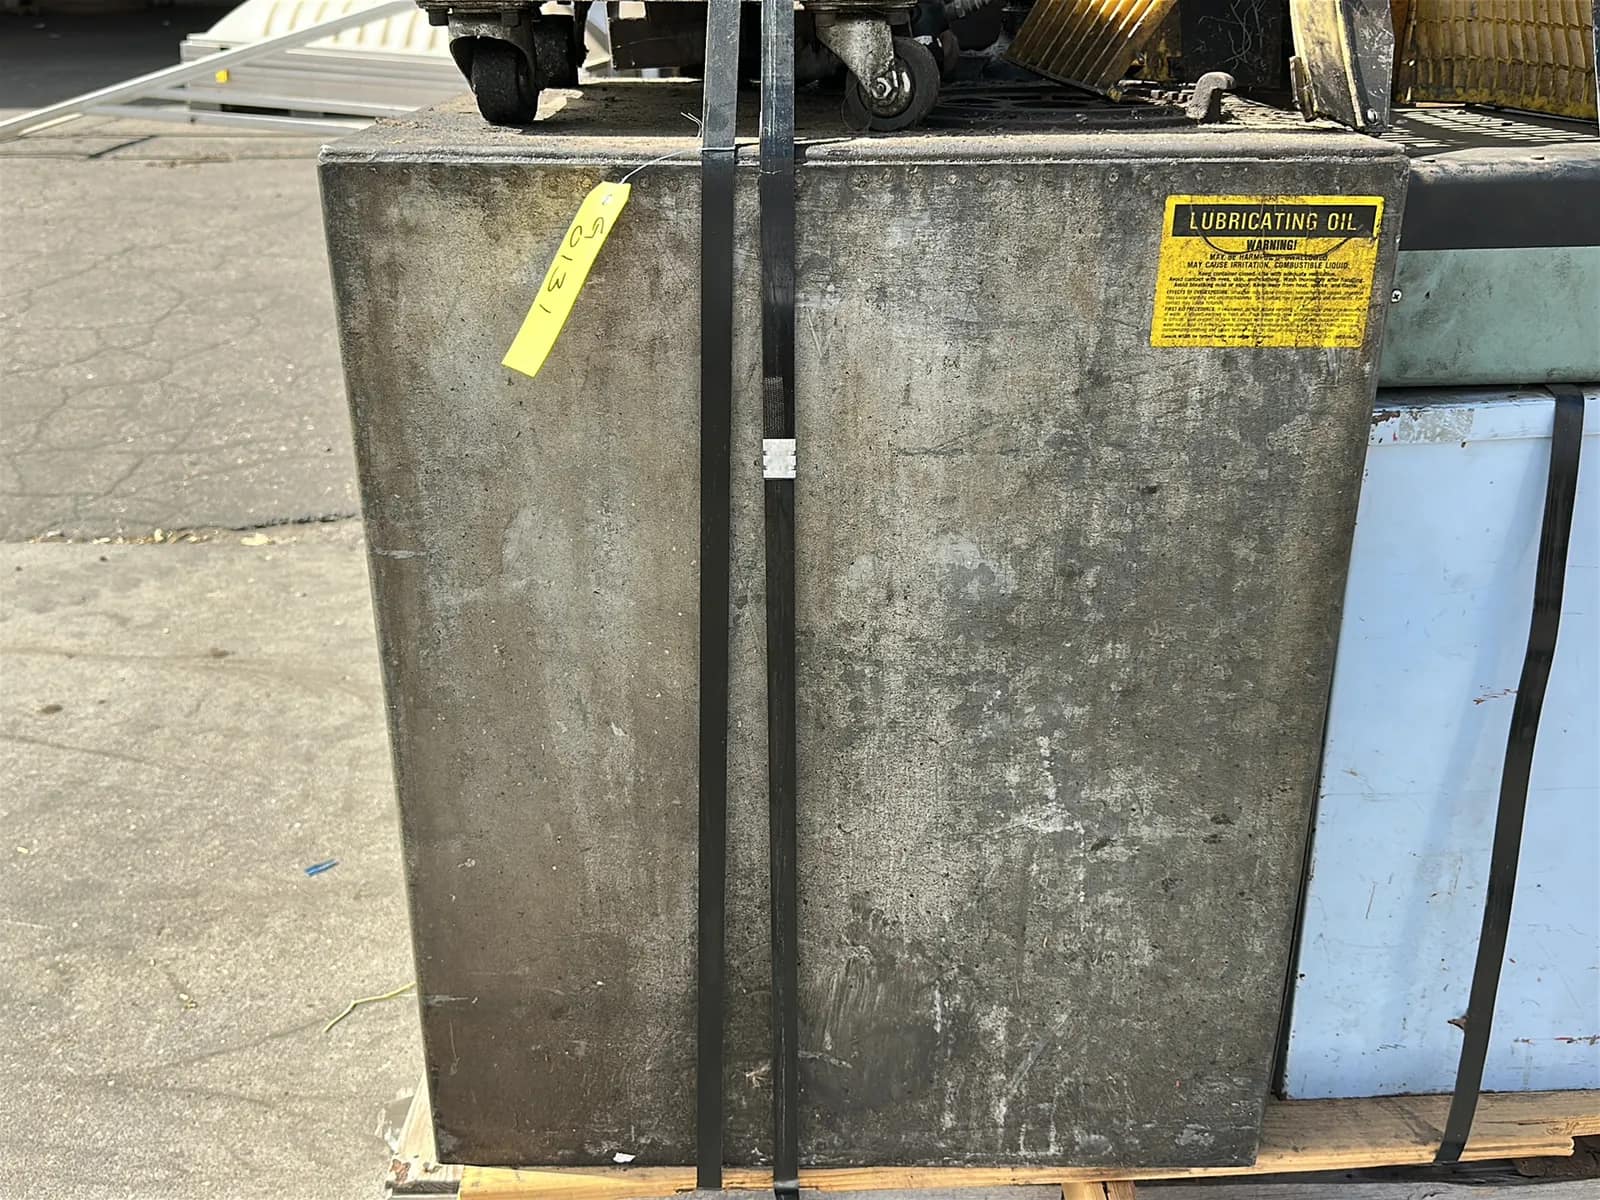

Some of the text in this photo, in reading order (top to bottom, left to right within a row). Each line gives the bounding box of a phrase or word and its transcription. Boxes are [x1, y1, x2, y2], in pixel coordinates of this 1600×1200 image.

[1189, 211, 1357, 231] LUBRICATING OIL
[1246, 239, 1297, 251] WARNING!
[1187, 261, 1202, 269] MAY
[1205, 261, 1228, 269] CAUSE
[1273, 261, 1322, 269] COMBUSTIBLE
